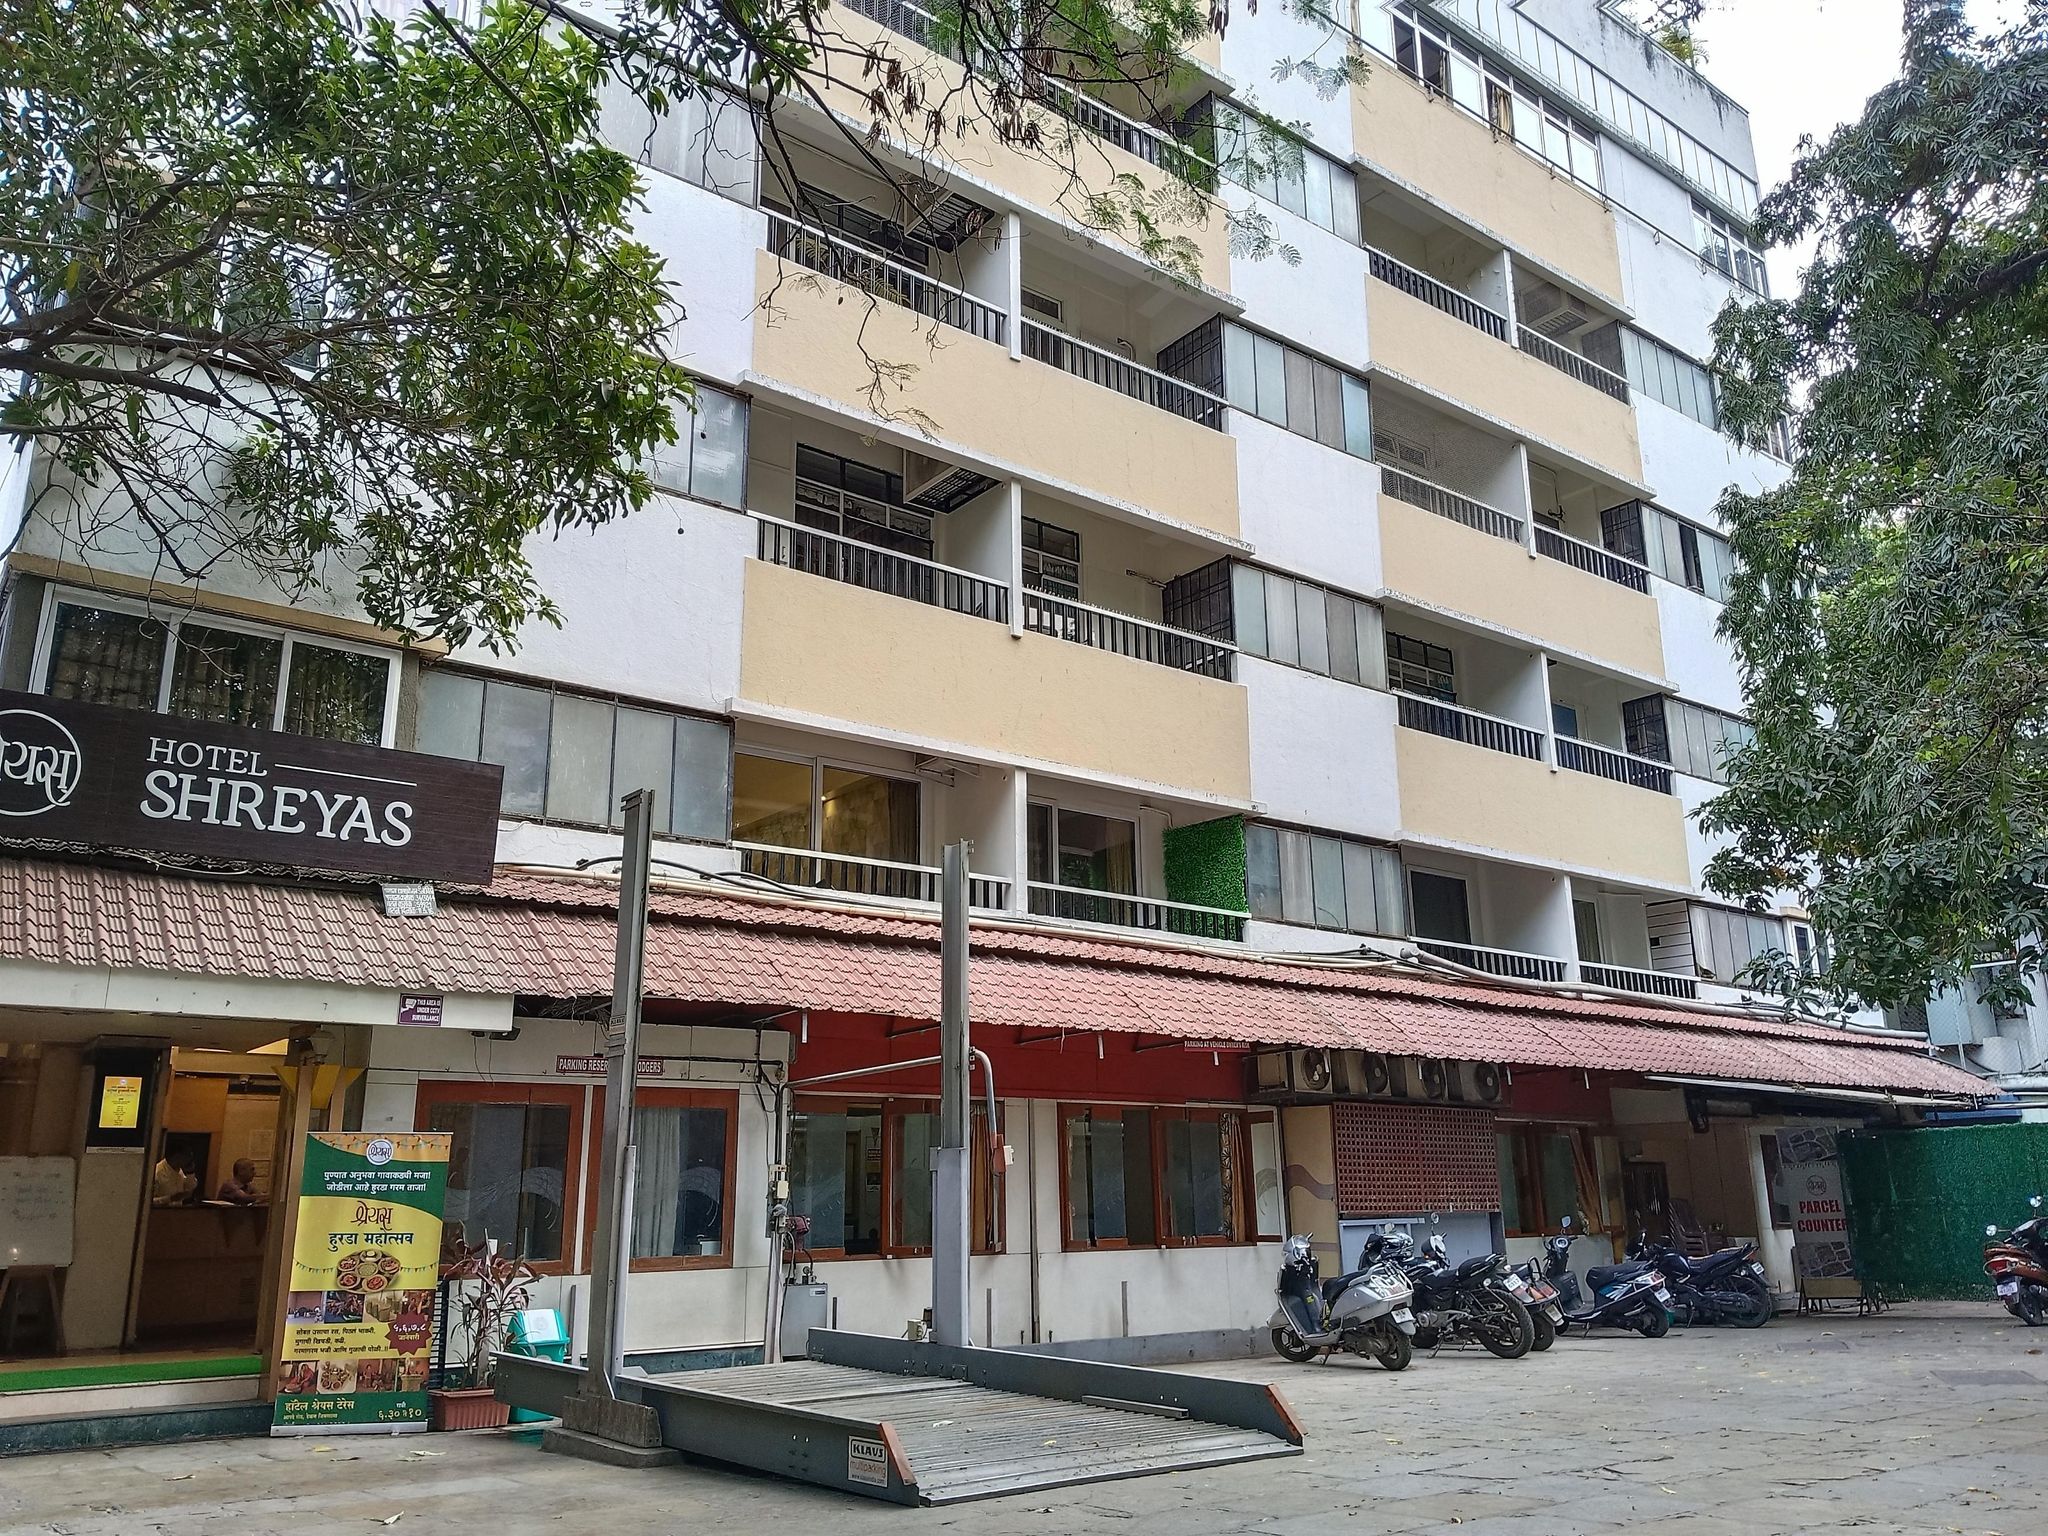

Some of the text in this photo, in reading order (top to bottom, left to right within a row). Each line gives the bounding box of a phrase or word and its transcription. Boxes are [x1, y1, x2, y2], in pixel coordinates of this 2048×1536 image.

[146, 736, 268, 777] HOTEL
[0, 740, 76, 808] यस
[139, 768, 414, 848] SHREYAS
[1184, 1040, 1203, 1048] PARKING
[559, 1058, 661, 1073] PARKING RESER ODGERS
[351, 1200, 394, 1232] श्रेयस
[1800, 1200, 1841, 1214] PARCEL
[328, 1229, 414, 1252] हुरडा महोत्सव
[285, 1398, 355, 1413] हॉटेल श्रेयस टेरेस
[853, 1444, 883, 1458] KLAUS
